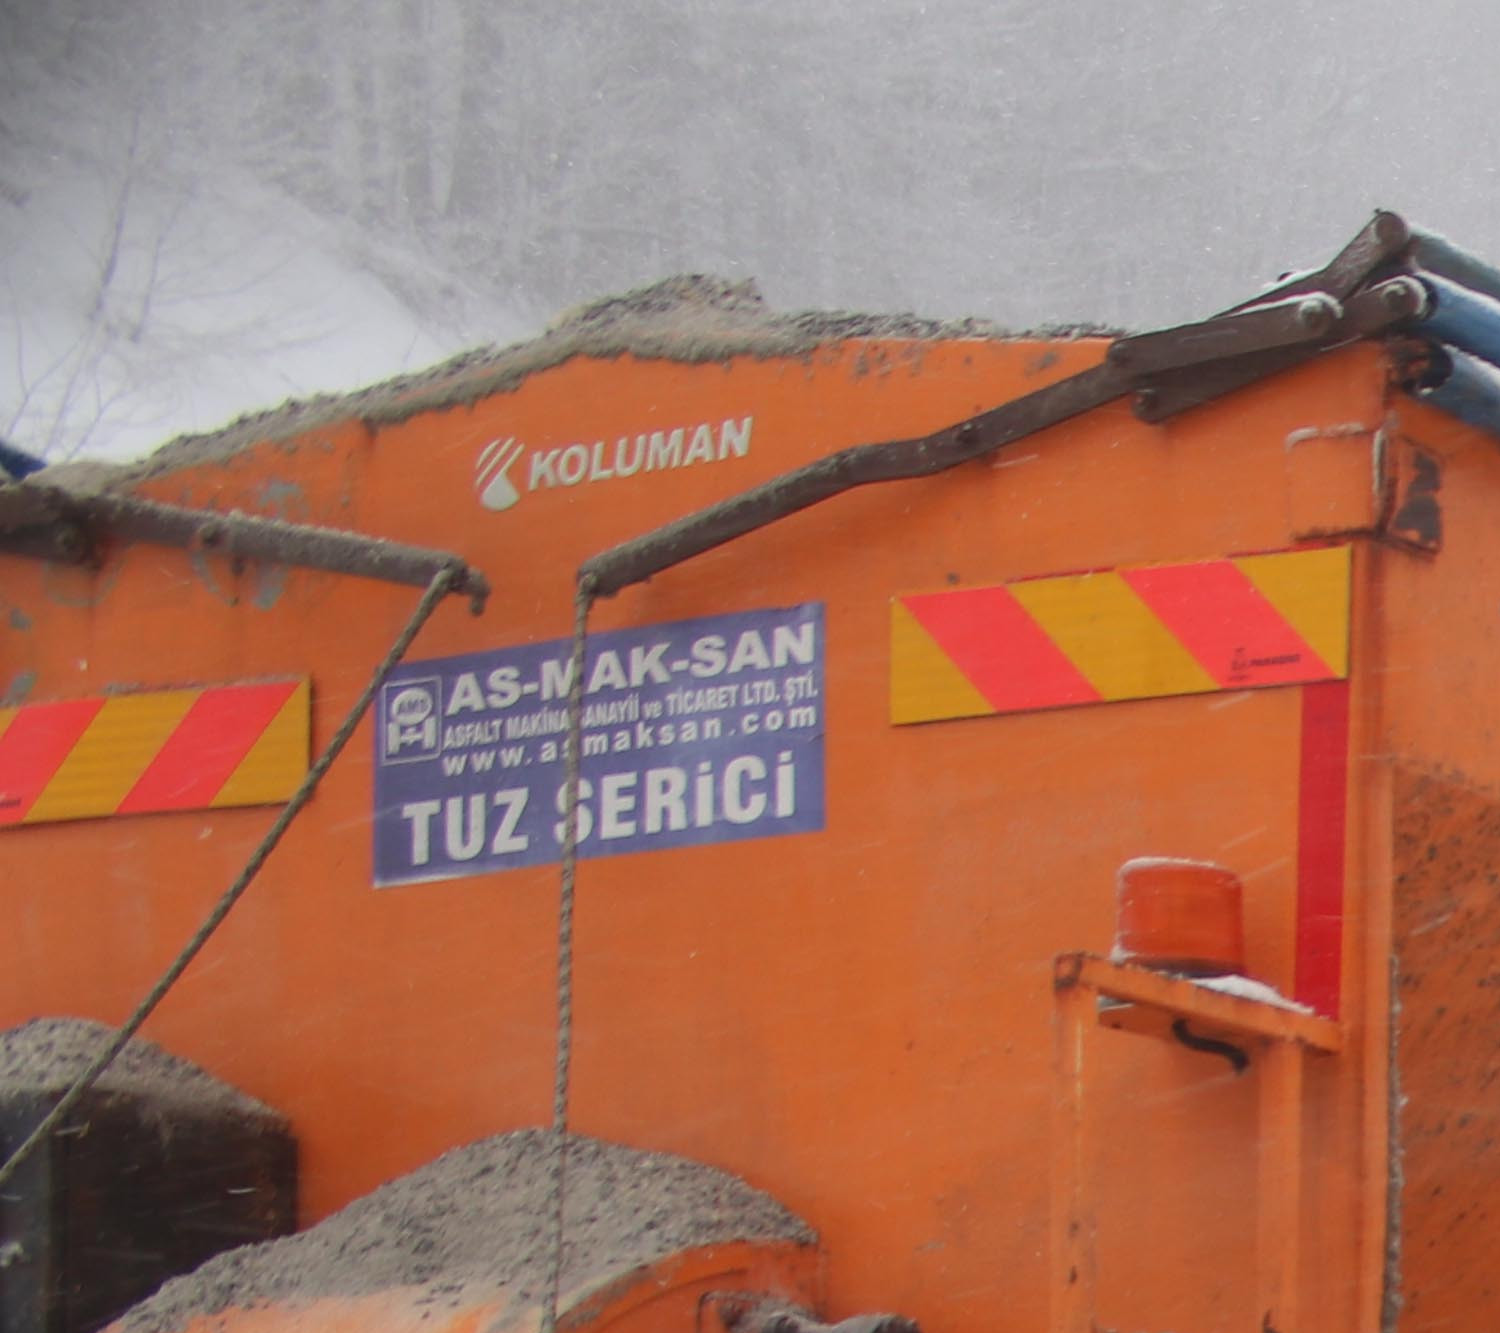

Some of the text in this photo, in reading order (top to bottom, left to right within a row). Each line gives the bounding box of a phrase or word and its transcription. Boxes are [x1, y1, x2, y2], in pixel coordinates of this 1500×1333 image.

[528, 416, 753, 491] KOLUMAN
[445, 622, 815, 716] AS-MAK-SAN
[443, 719, 502, 750] ASFALT
[576, 693, 640, 729] ANAYİİ
[644, 701, 662, 720] ve
[666, 686, 739, 716] TİCARET
[742, 679, 781, 707] LTD.
[402, 787, 529, 865] TUZ
